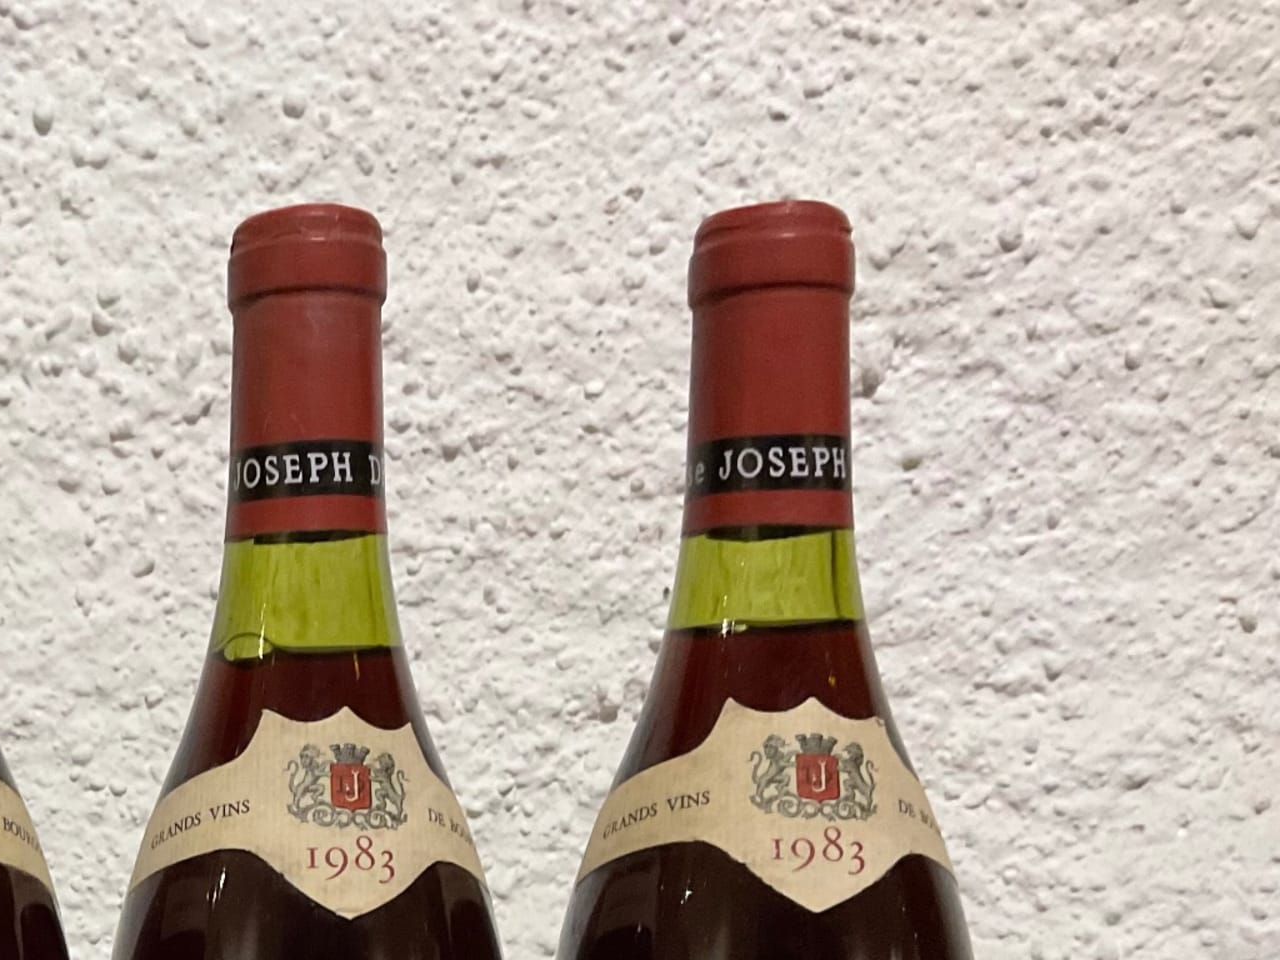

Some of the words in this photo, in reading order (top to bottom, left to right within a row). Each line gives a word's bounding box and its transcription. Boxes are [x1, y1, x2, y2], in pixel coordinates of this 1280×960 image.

[232, 451, 354, 492] JOSEPH
[718, 446, 847, 481] JOSEPH
[150, 811, 202, 850] GRANDS
[208, 799, 251, 823] VINS
[428, 807, 446, 829] DE
[603, 802, 658, 840] GRANDS
[666, 790, 711, 813] VINS
[898, 798, 917, 819] DE
[306, 835, 396, 885] 1983
[771, 826, 867, 876] 1983
